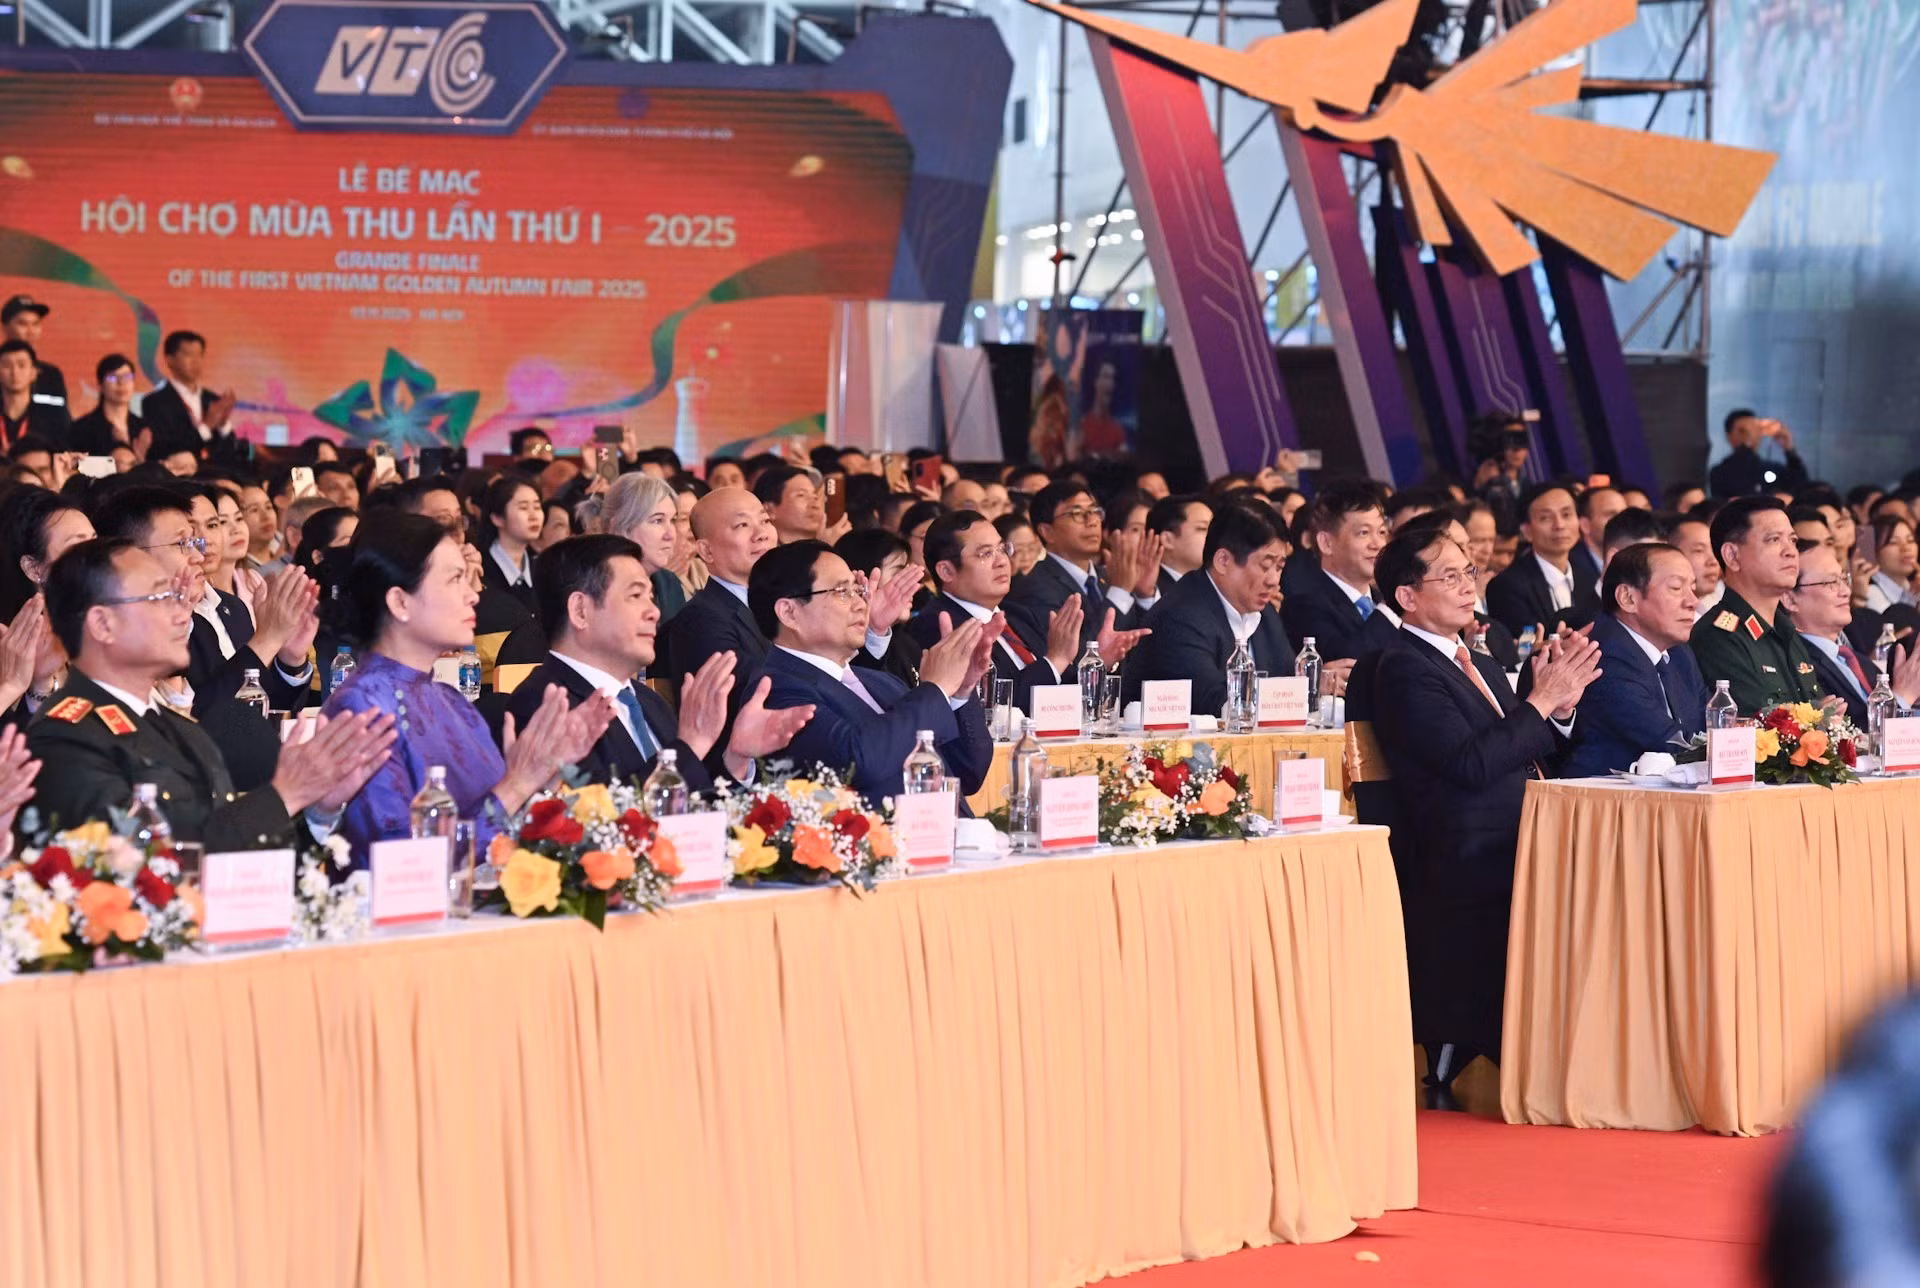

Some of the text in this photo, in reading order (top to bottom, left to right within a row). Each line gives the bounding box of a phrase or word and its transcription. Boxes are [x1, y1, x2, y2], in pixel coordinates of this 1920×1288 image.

[342, 206, 416, 240] THU
[645, 212, 737, 248] 2025
[418, 252, 479, 273] FINALE
[168, 269, 647, 299] OF THE FIRST VIETNAM GOLDEN AUTUMN FAIR 2025
